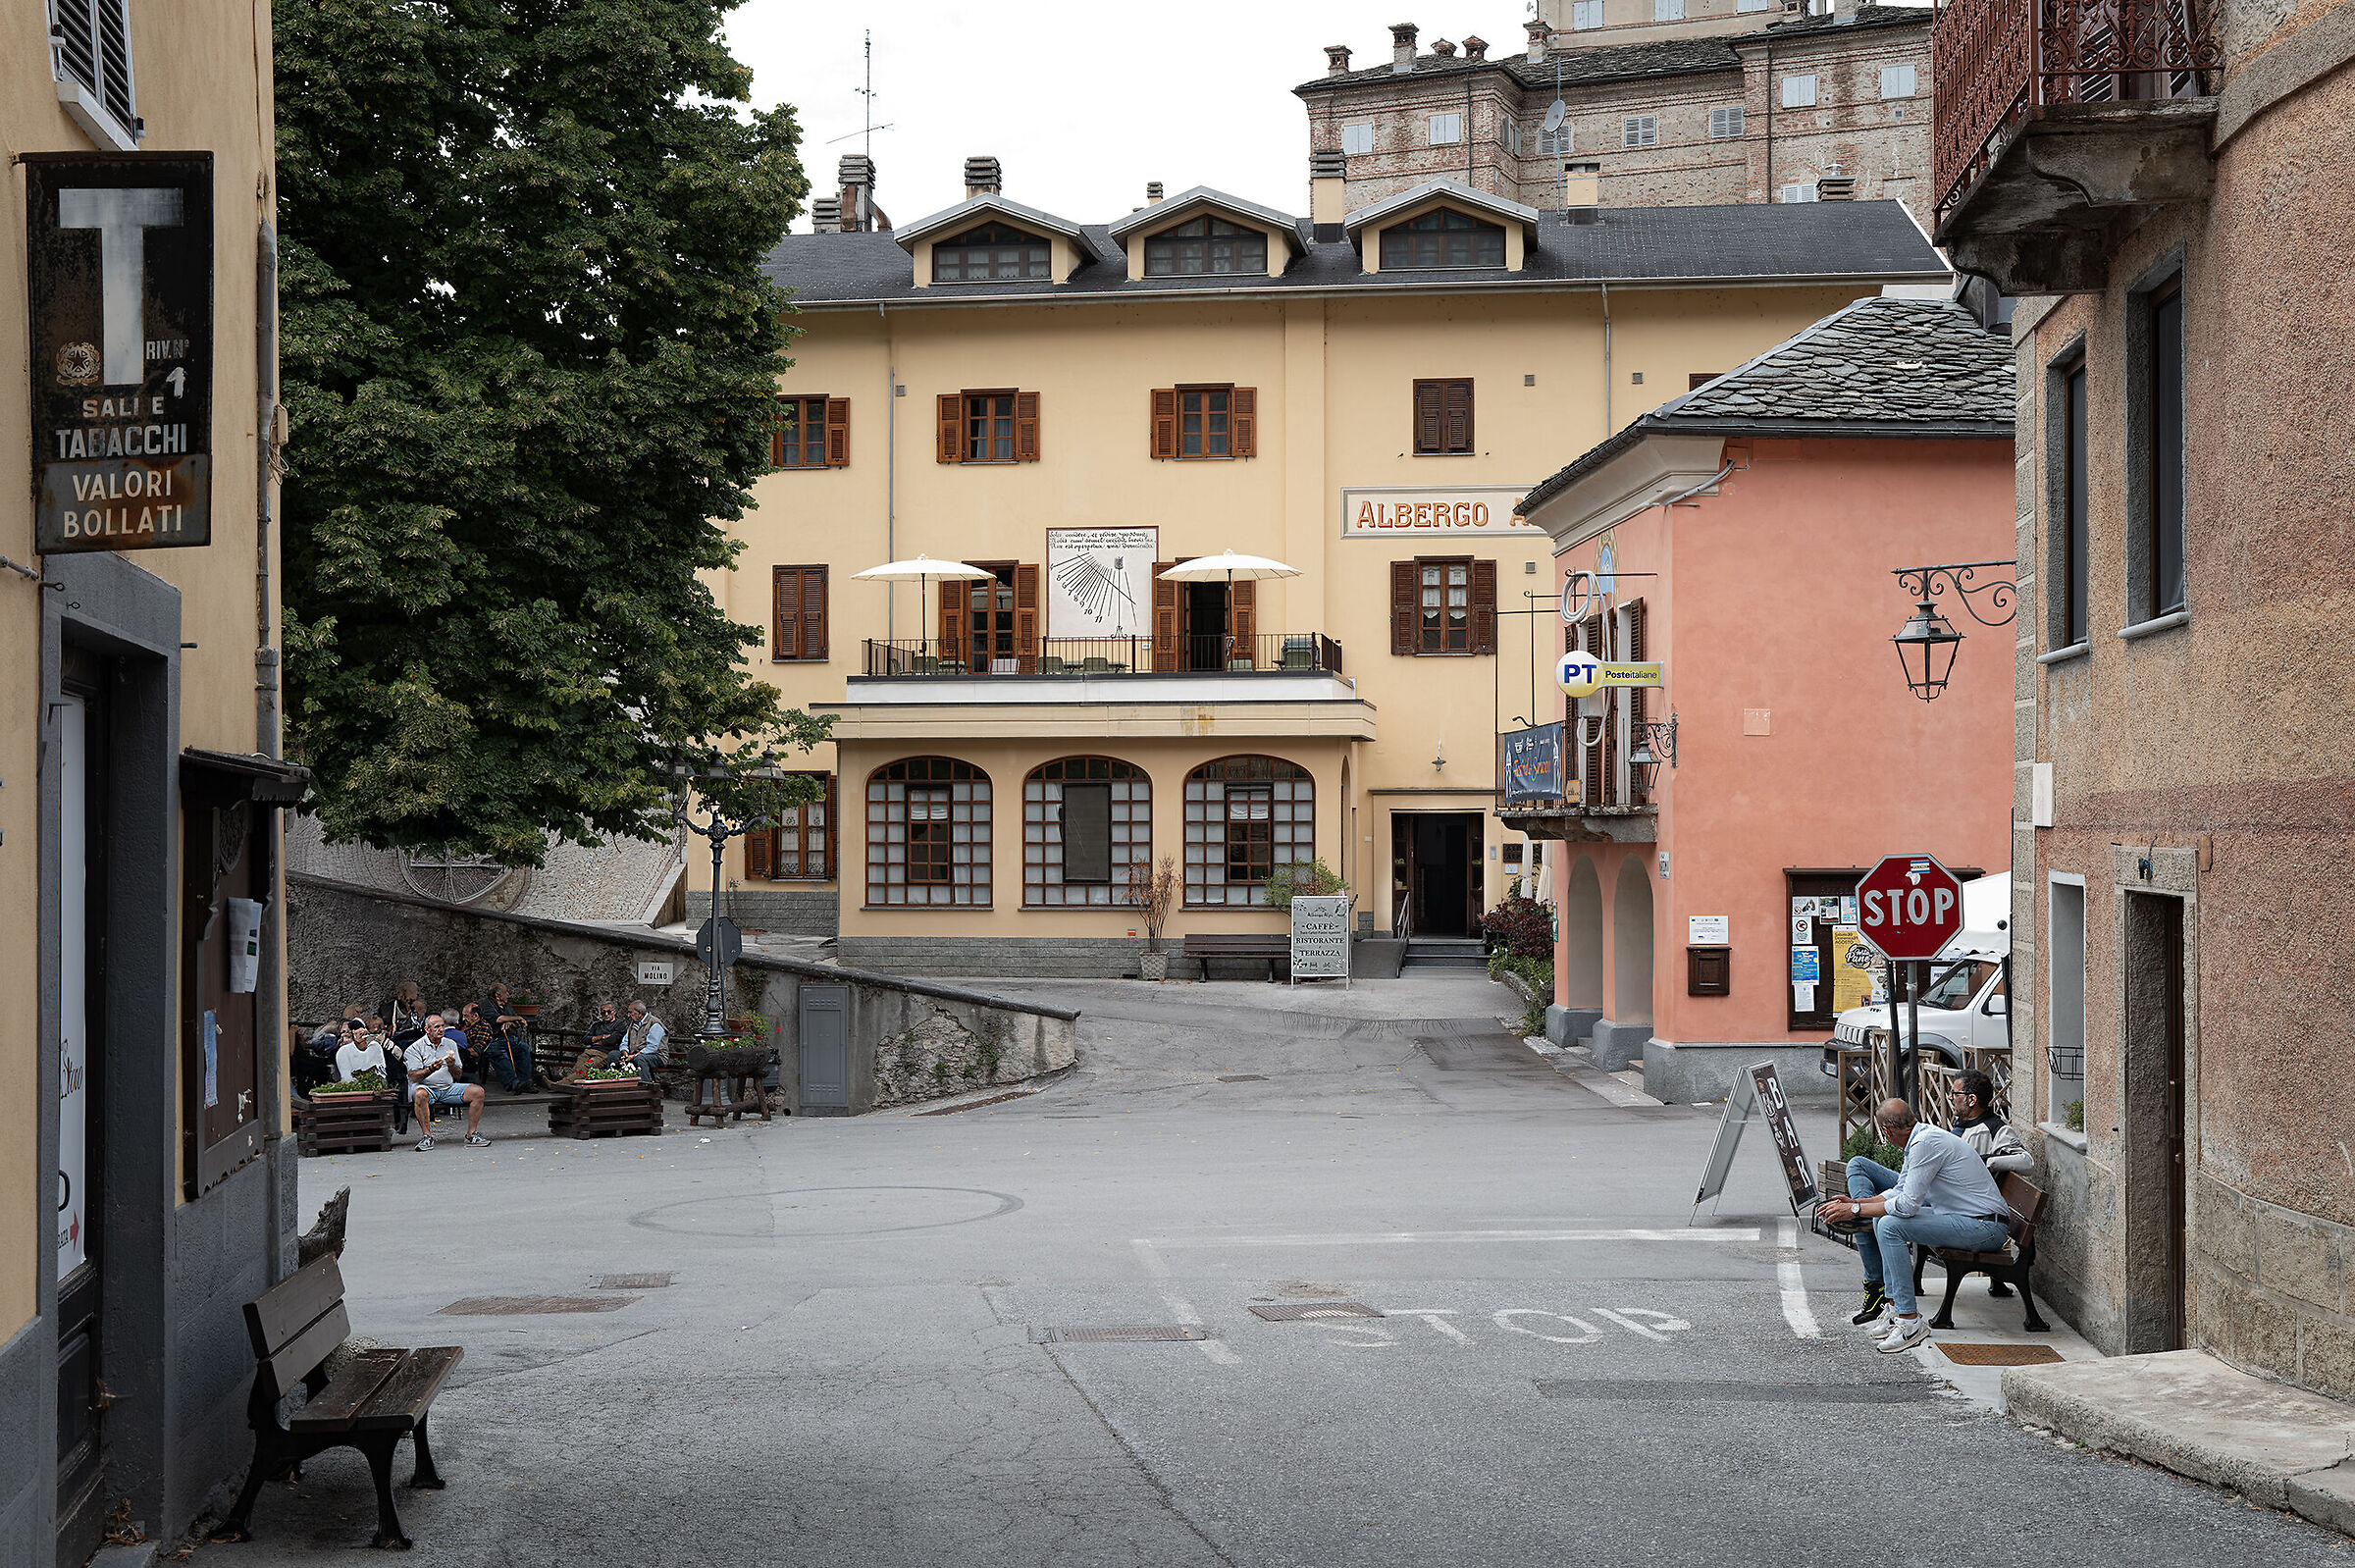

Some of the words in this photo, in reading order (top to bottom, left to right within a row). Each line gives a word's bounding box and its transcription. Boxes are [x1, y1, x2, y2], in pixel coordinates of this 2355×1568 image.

[59, 188, 183, 386] T
[165, 366, 185, 398] 1
[82, 397, 139, 418] SALI
[152, 395, 165, 415] E
[55, 423, 186, 459] TABACCHI
[73, 469, 173, 502] VALORI
[63, 503, 183, 539] BOLLATI
[1357, 499, 1489, 529] ALBERGO
[1563, 663, 1597, 684] PT
[1864, 887, 1955, 927] STOP
[1767, 1077, 1812, 1189] BAR
